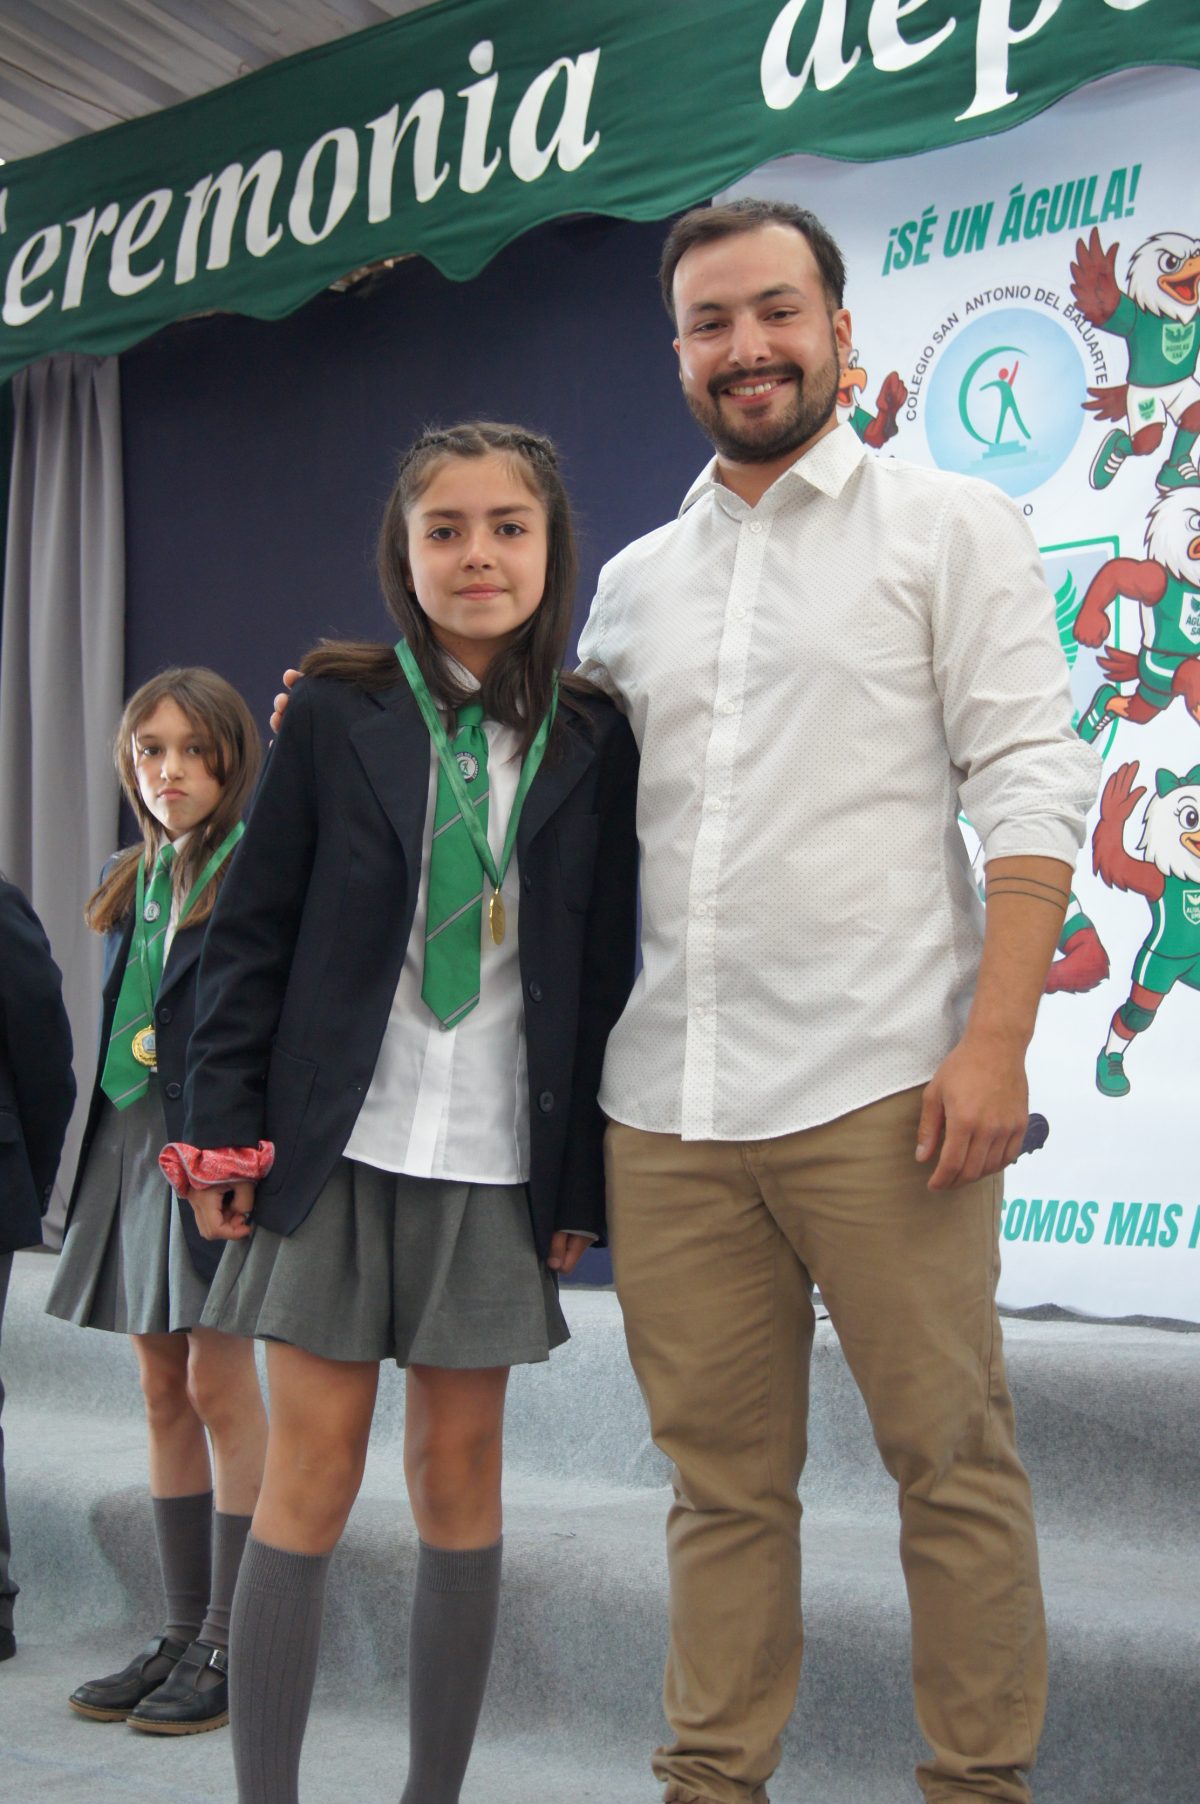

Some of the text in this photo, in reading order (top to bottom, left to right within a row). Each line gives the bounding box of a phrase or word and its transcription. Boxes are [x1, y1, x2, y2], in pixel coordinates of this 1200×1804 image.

[0, 39, 601, 326] eremonia
[882, 163, 1142, 277] ¡SÉ UN ÁGUILA!
[906, 285, 1108, 422] COLEGIO SAN ANTONIO DEL BALUARTE
[1001, 1198, 1099, 1244] OMOS
[1104, 1202, 1183, 1248] MAS
